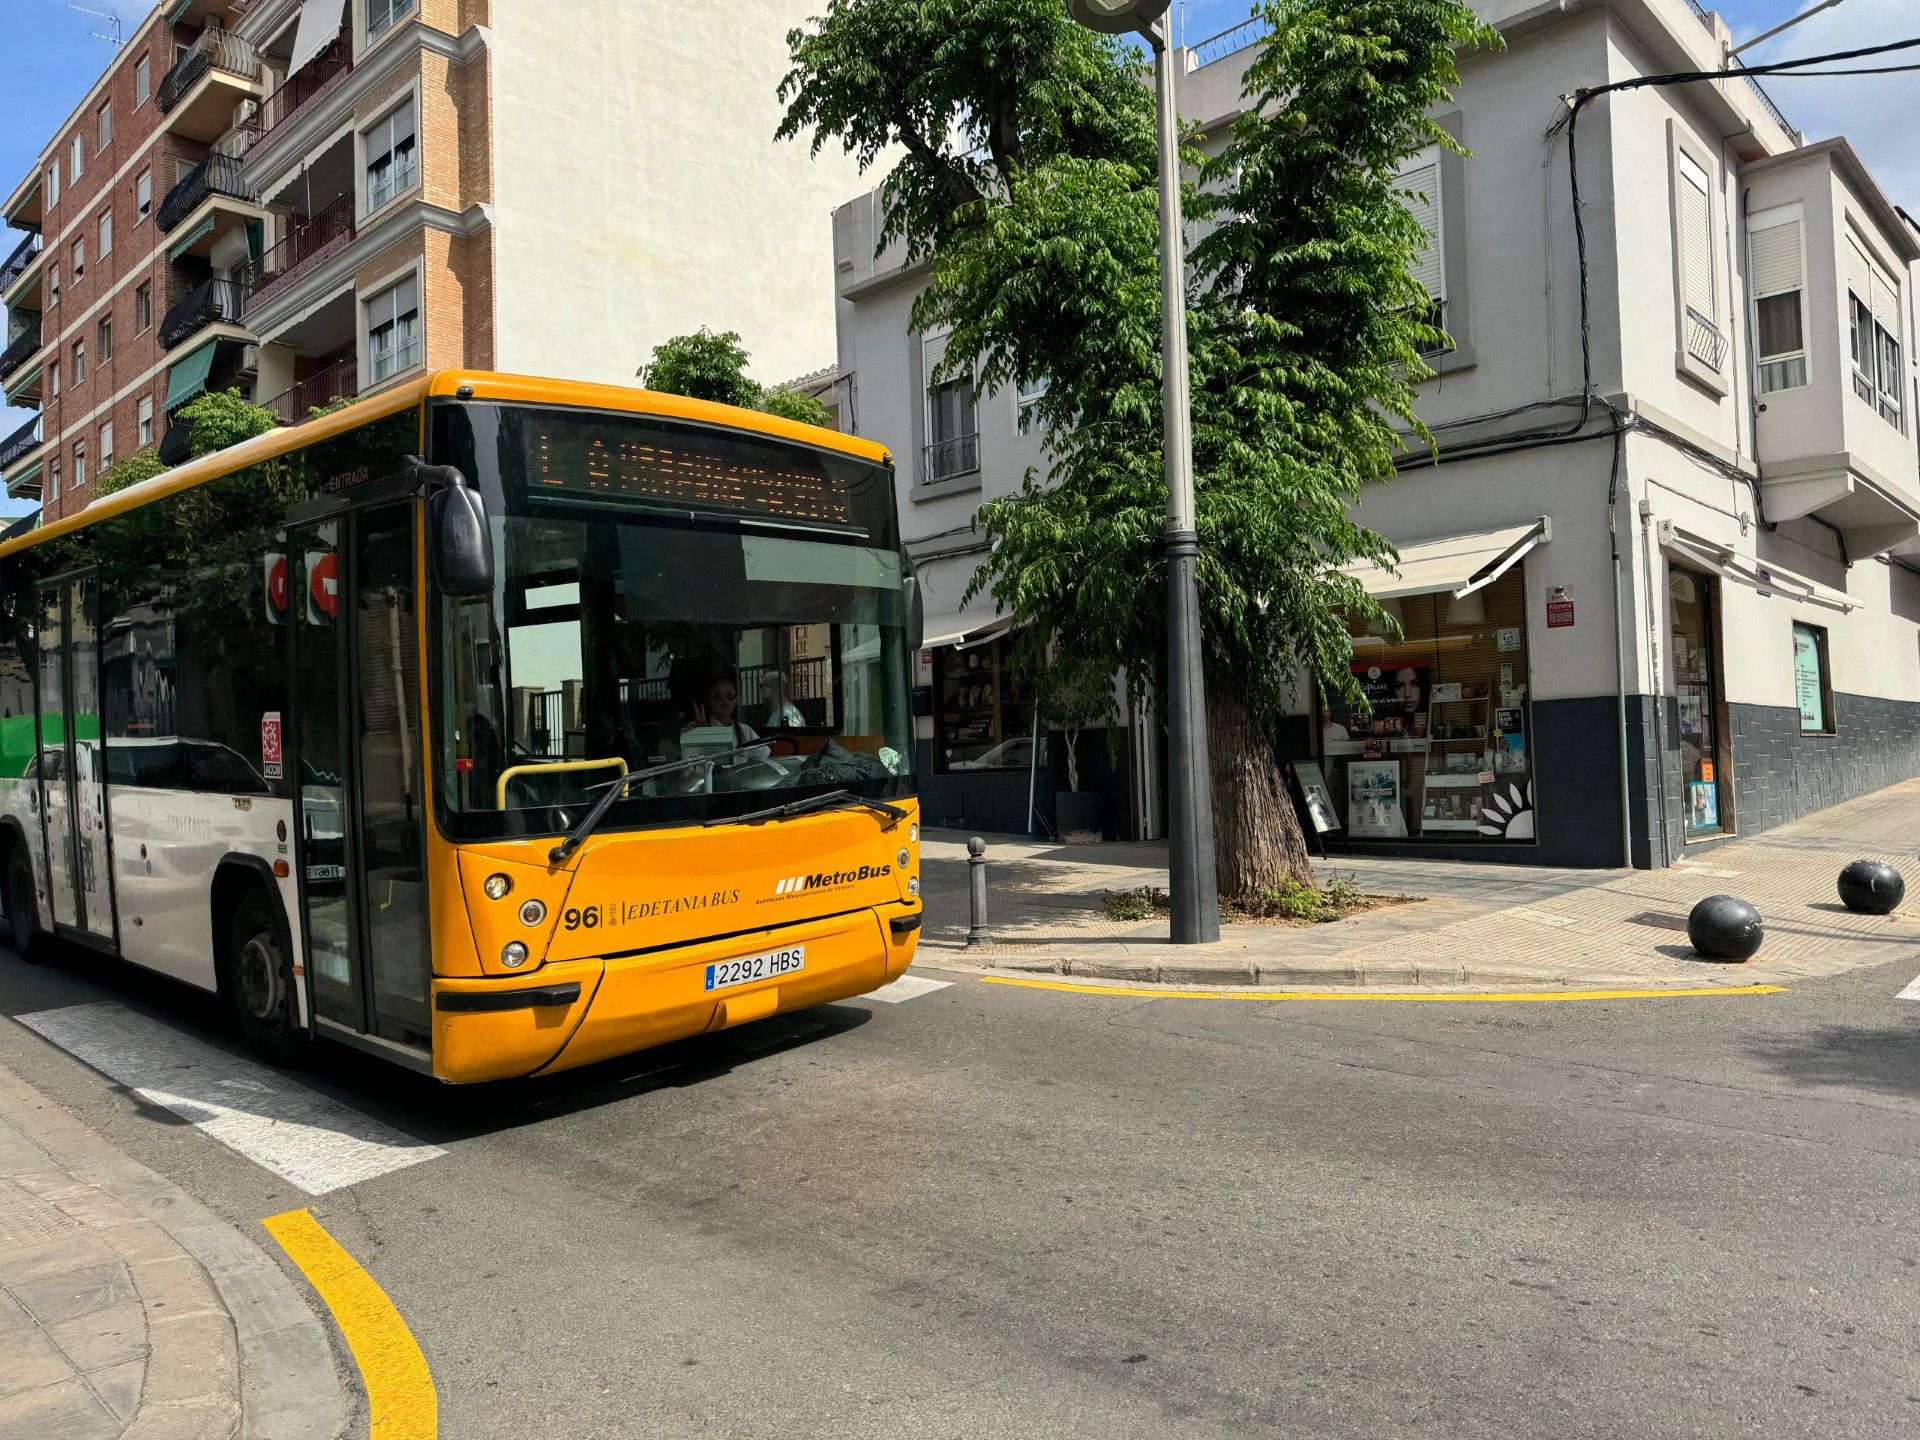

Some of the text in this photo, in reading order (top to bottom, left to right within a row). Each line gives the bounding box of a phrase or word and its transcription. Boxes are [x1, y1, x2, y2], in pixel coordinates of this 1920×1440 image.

[329, 467, 369, 491] ENTRADA
[803, 864, 891, 890] MetroBus
[627, 889, 740, 920] EDETANIA BUS
[564, 905, 599, 931] 96
[718, 949, 801, 985] 2292 HBS
